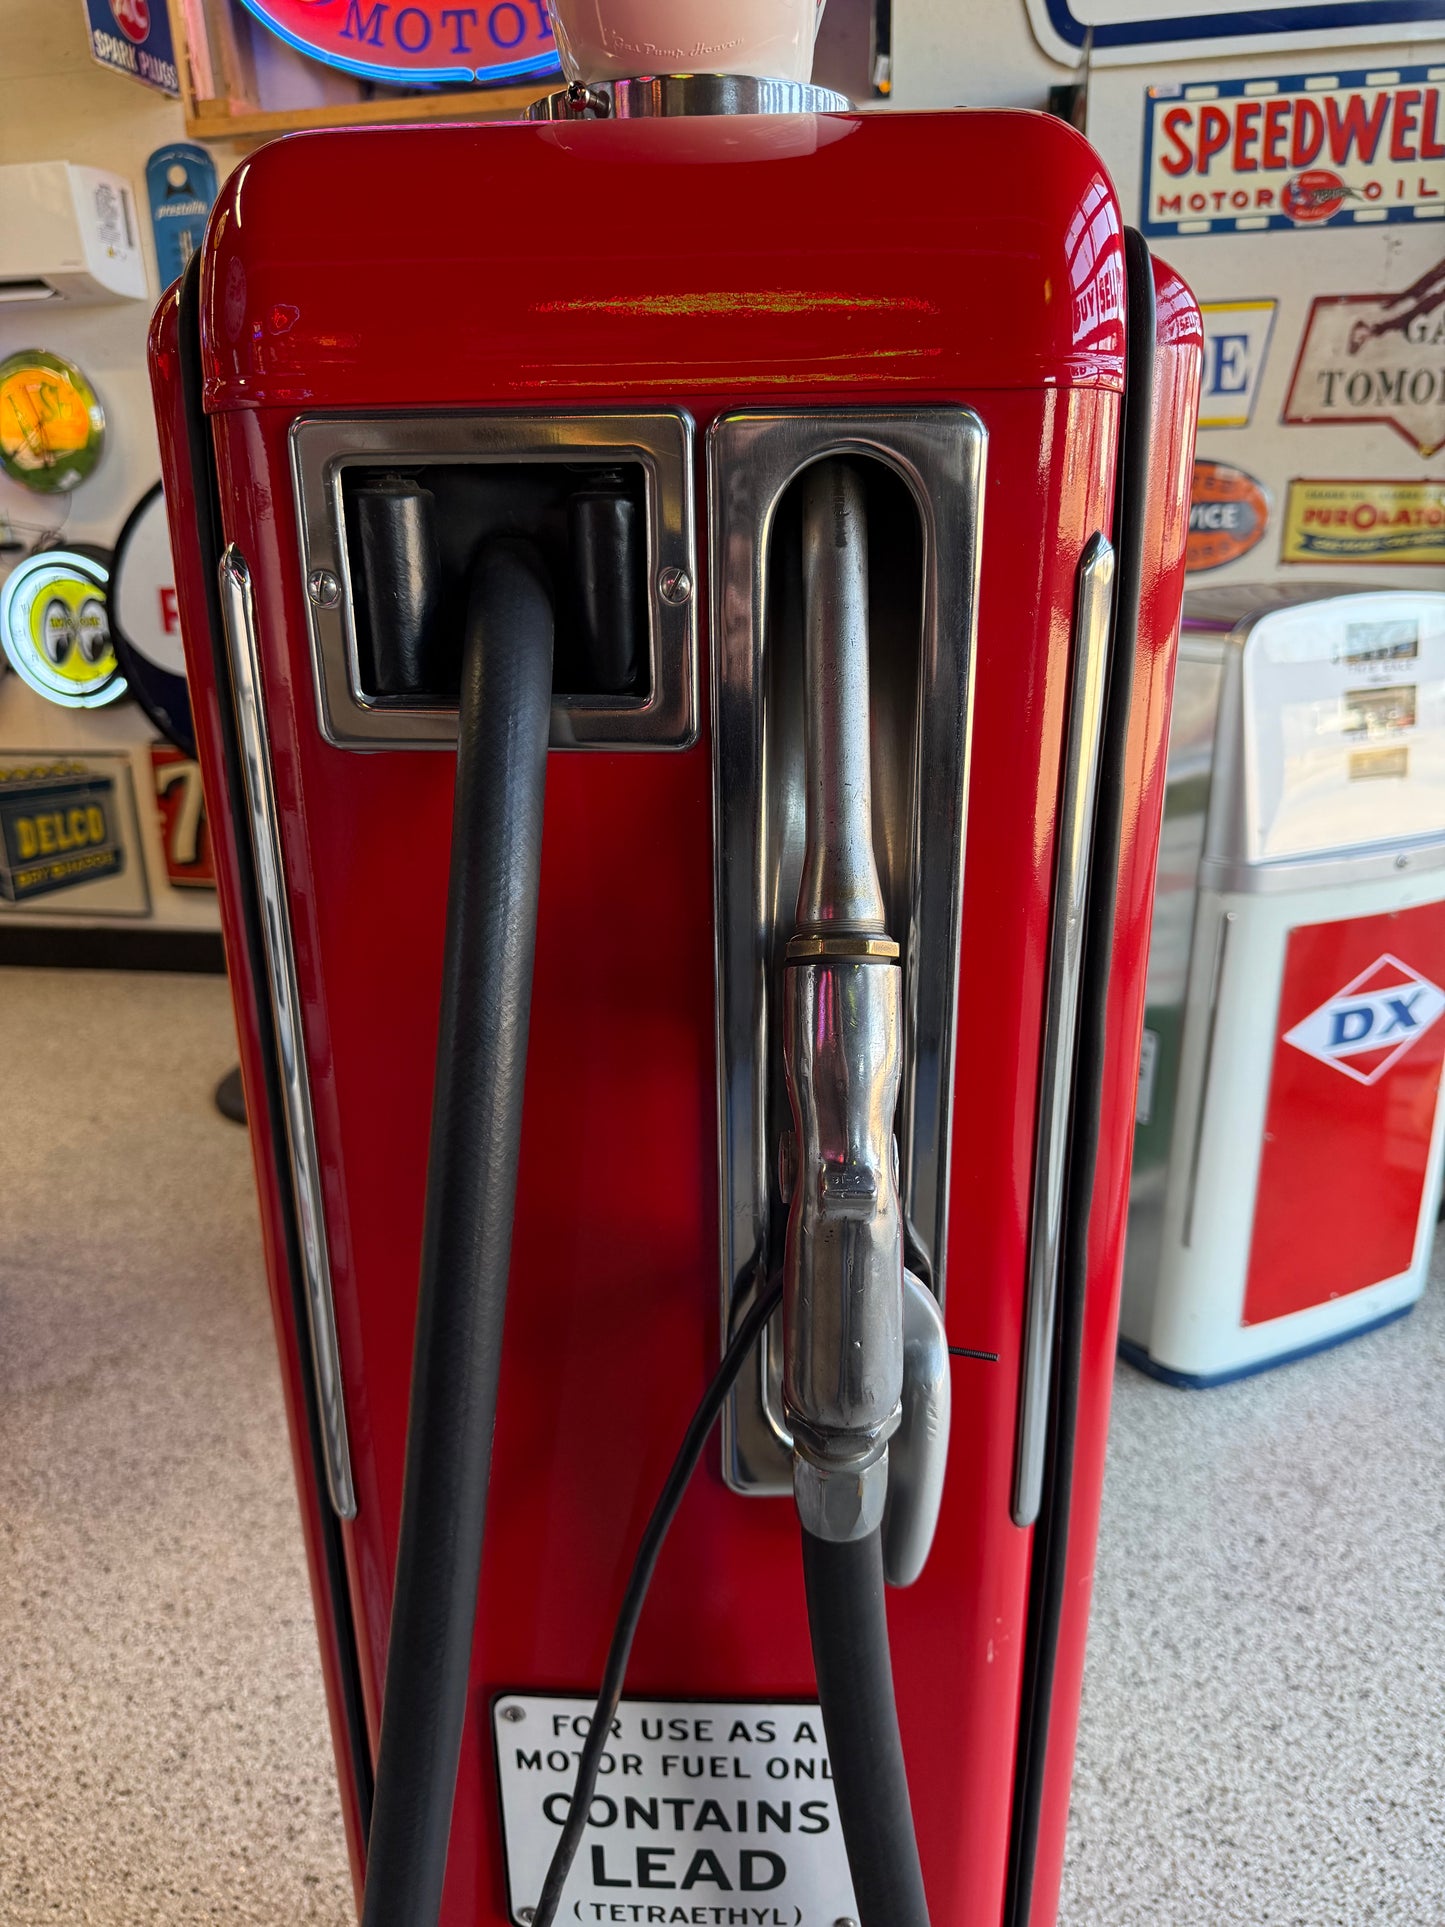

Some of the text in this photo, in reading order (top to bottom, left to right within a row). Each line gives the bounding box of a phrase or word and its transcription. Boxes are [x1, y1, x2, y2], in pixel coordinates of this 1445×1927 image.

[93, 29, 179, 90] SPARK PLUGS
[644, 42, 685, 59] Pump
[1160, 88, 1445, 177] SPEEDWEL
[1157, 188, 1274, 215] MOTOR
[1364, 178, 1439, 200] OIL
[17, 806, 105, 859] DELCO
[157, 761, 201, 865] 7
[1327, 988, 1429, 1046] DX
[553, 1715, 818, 1744] FOR USE AS A
[662, 1756, 752, 1779] FUEL
[766, 1757, 835, 1780] ONL
[542, 1792, 831, 1835] CONTAINS
[591, 1844, 787, 1892] LEAD
